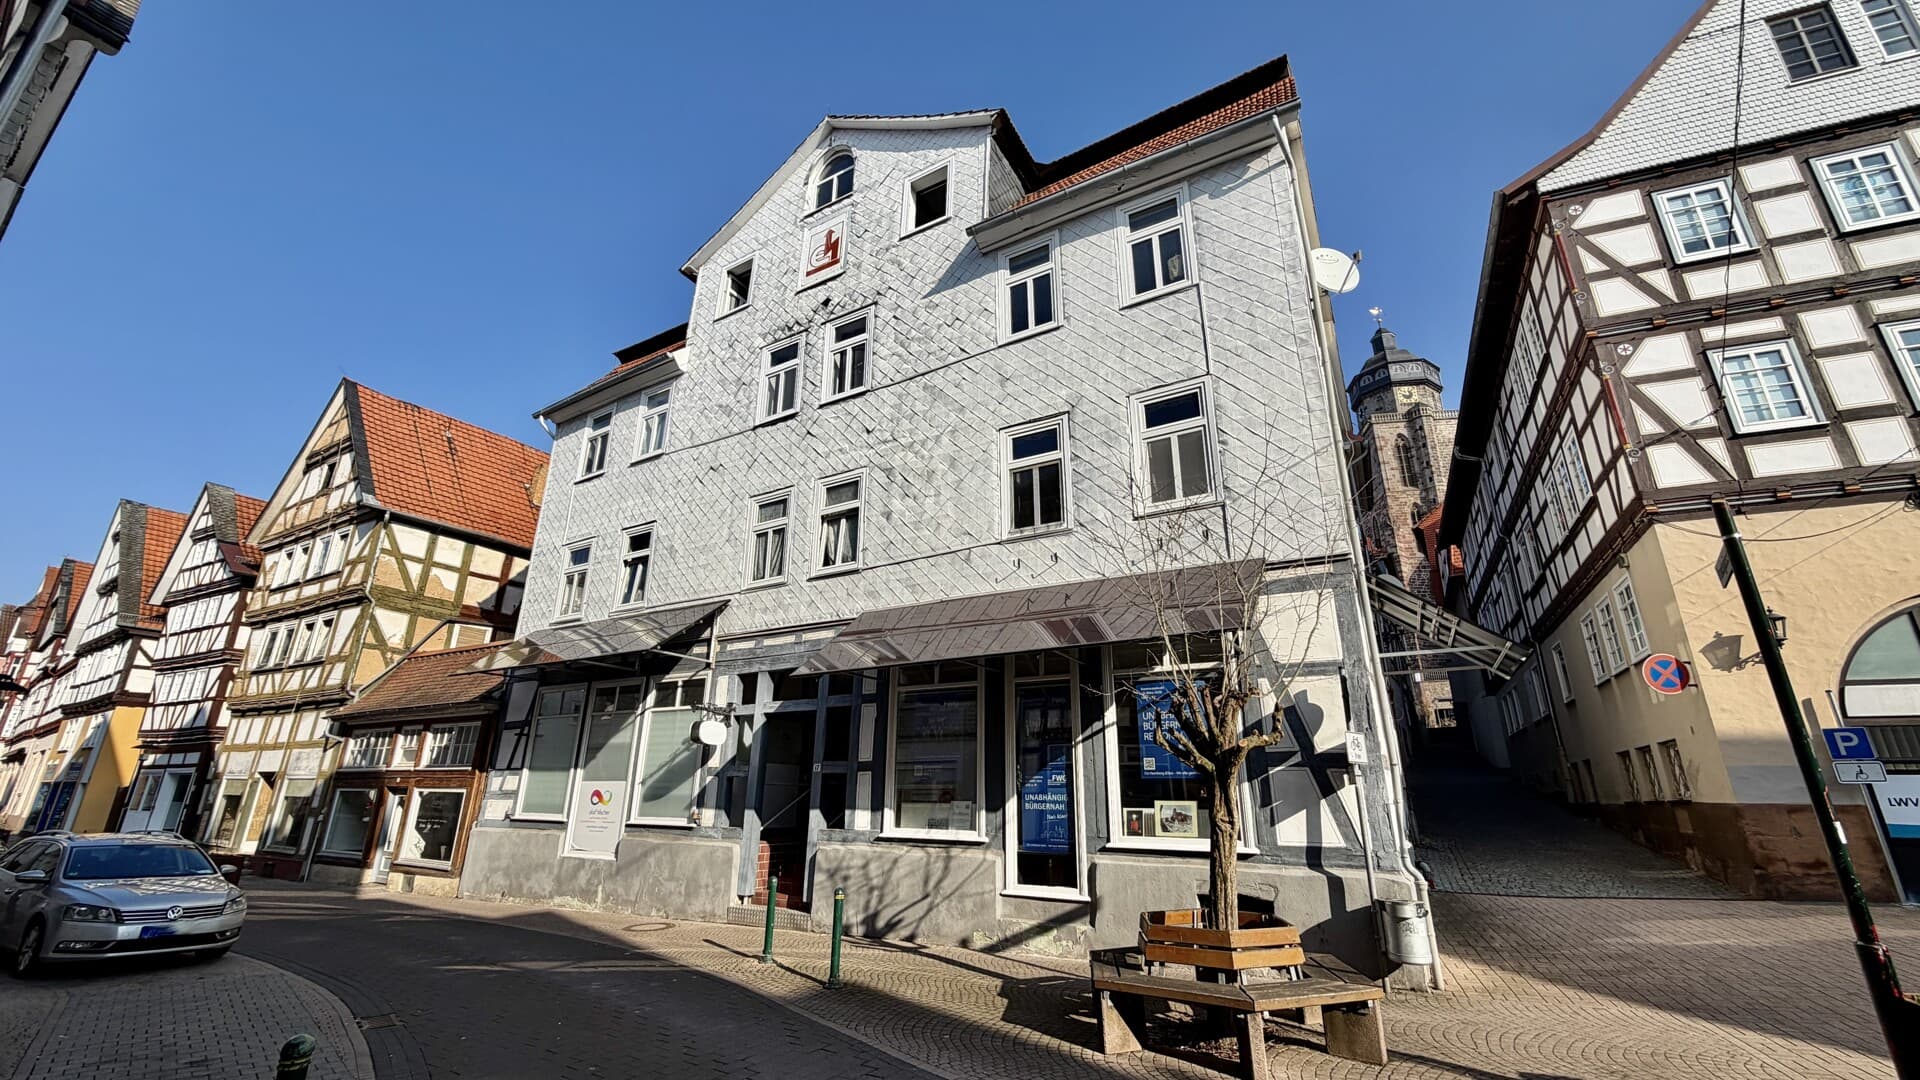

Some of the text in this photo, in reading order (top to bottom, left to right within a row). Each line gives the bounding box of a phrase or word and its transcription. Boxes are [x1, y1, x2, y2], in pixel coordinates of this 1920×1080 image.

[1834, 732, 1859, 756] P
[1025, 801, 1065, 811] BÜRGERNAH
[1887, 797, 1919, 808] LWV
